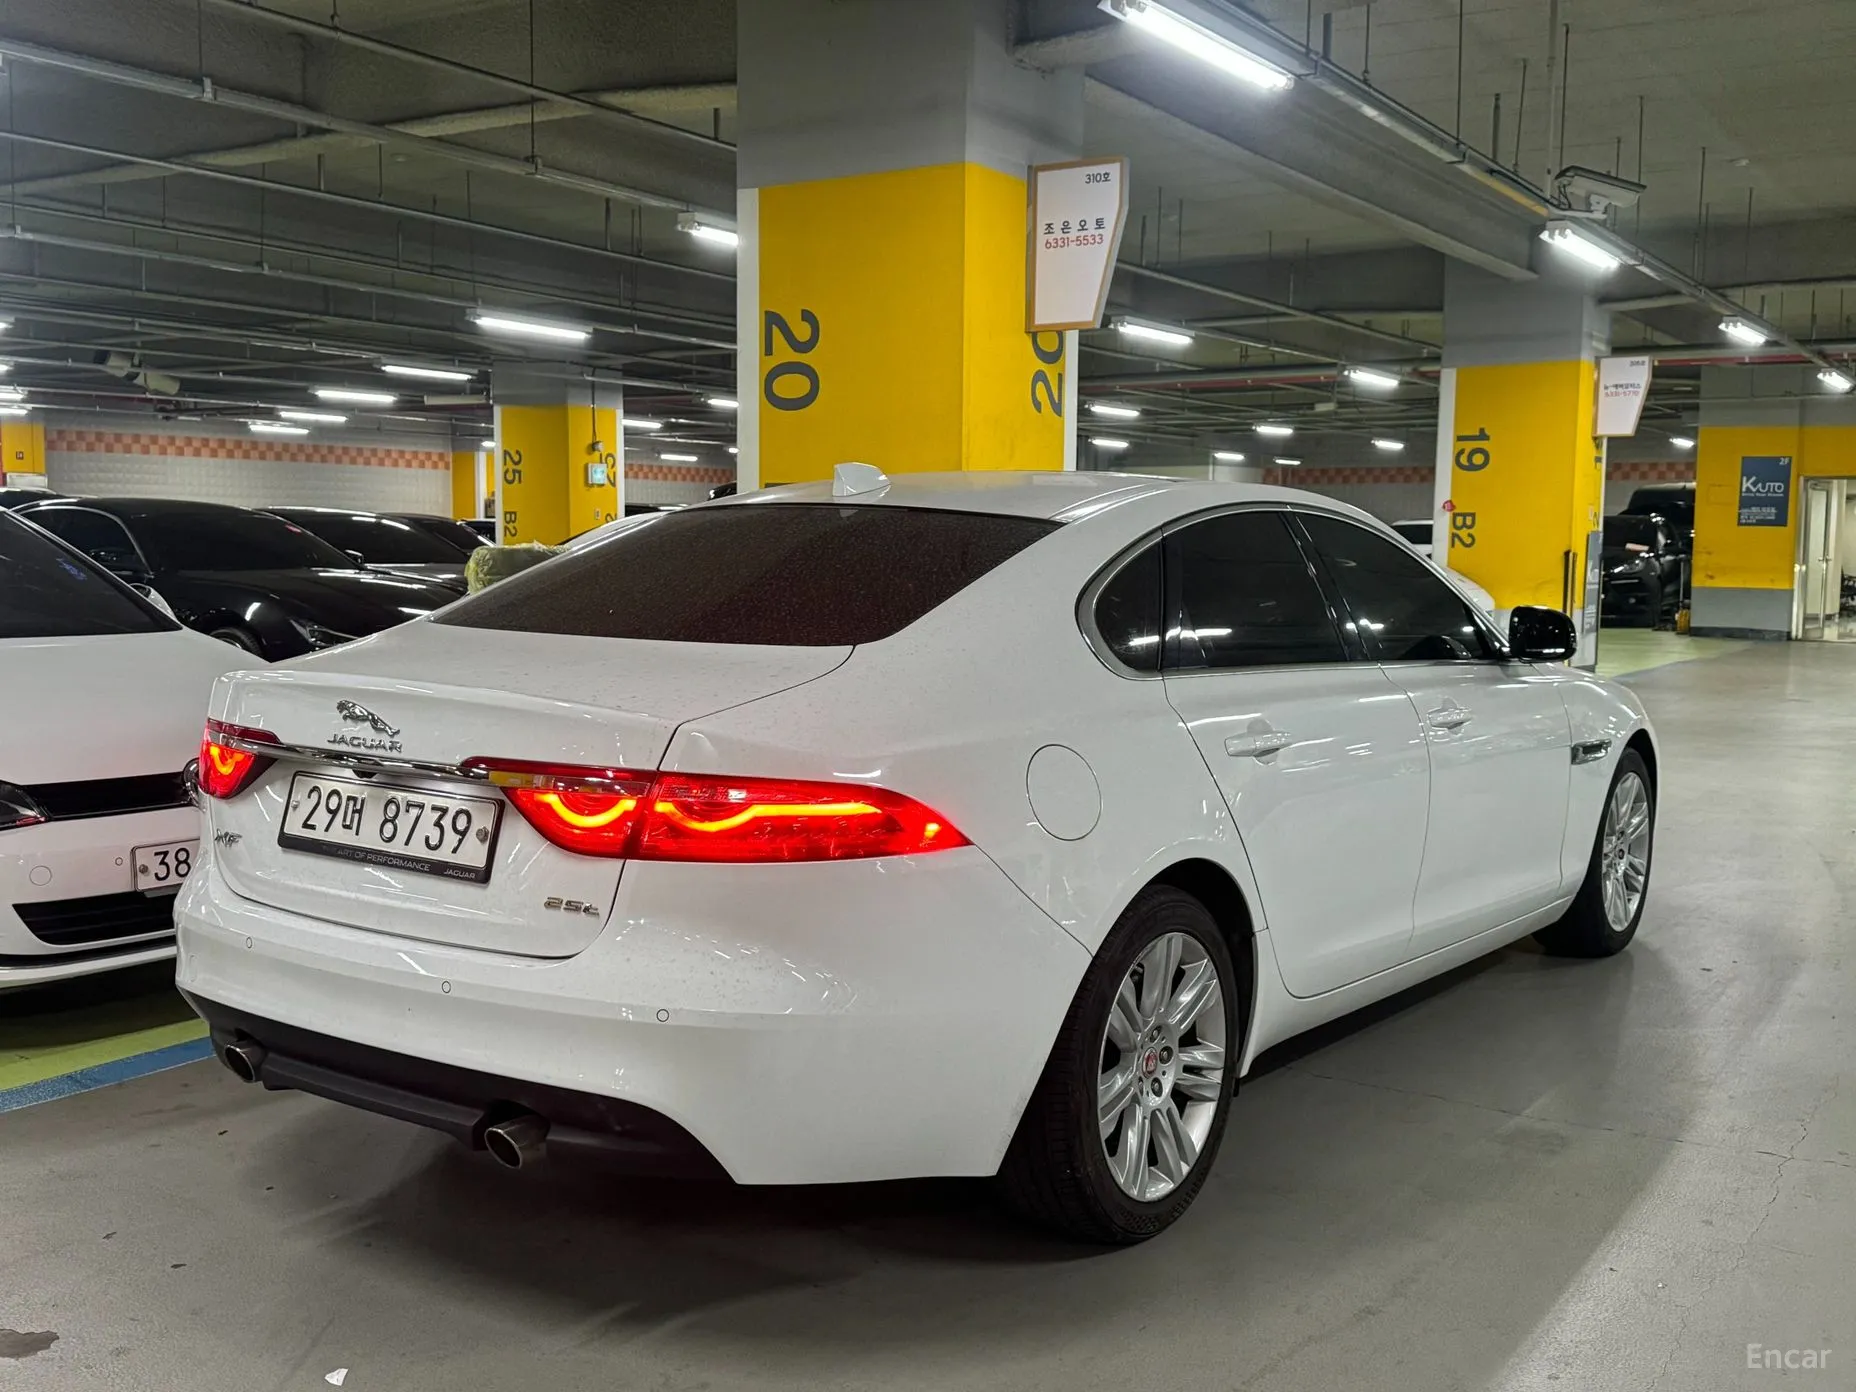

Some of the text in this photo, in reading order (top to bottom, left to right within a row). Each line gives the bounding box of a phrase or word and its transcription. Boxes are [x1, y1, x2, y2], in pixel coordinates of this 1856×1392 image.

[1085, 172, 1111, 184] 310호
[1044, 234, 1104, 250] 6331-5533
[764, 308, 820, 411] 20
[1454, 427, 1490, 472] 19
[503, 449, 522, 485] 25
[504, 511, 517, 538] B2
[1451, 512, 1477, 549] B2
[327, 733, 403, 753] JAGUAR
[379, 797, 472, 855] 8739
[154, 847, 191, 881] 38
[355, 851, 367, 860] OF
[366, 853, 431, 872] PERFORMANCE
[443, 868, 476, 879] JAGUAR
